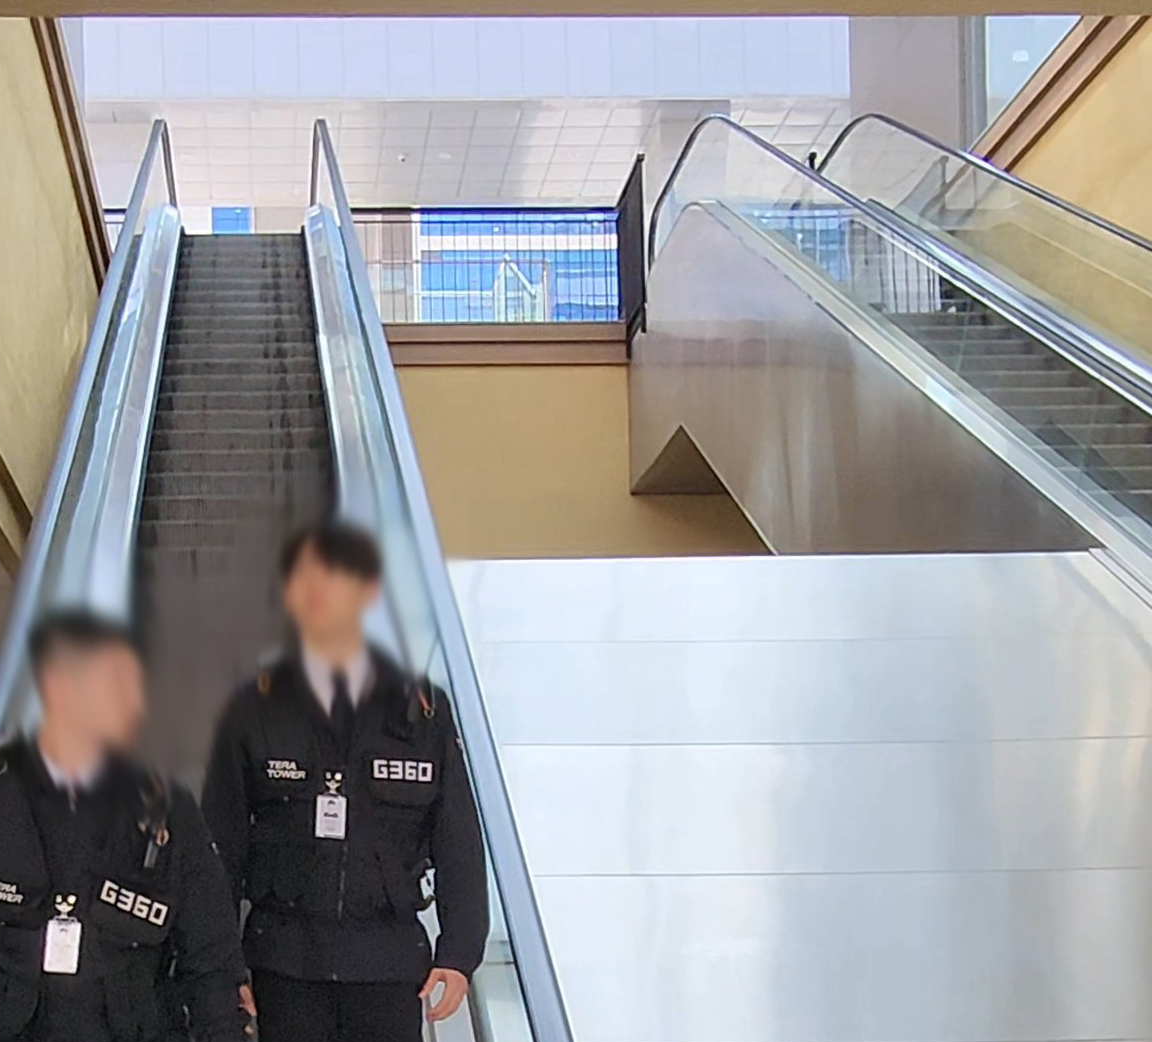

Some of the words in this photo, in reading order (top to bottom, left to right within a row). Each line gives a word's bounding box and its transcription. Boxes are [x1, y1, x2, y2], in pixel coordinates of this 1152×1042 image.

[268, 760, 297, 770] TERA
[373, 759, 433, 782] G360
[266, 769, 306, 780] TOWER
[100, 879, 169, 926] G360
